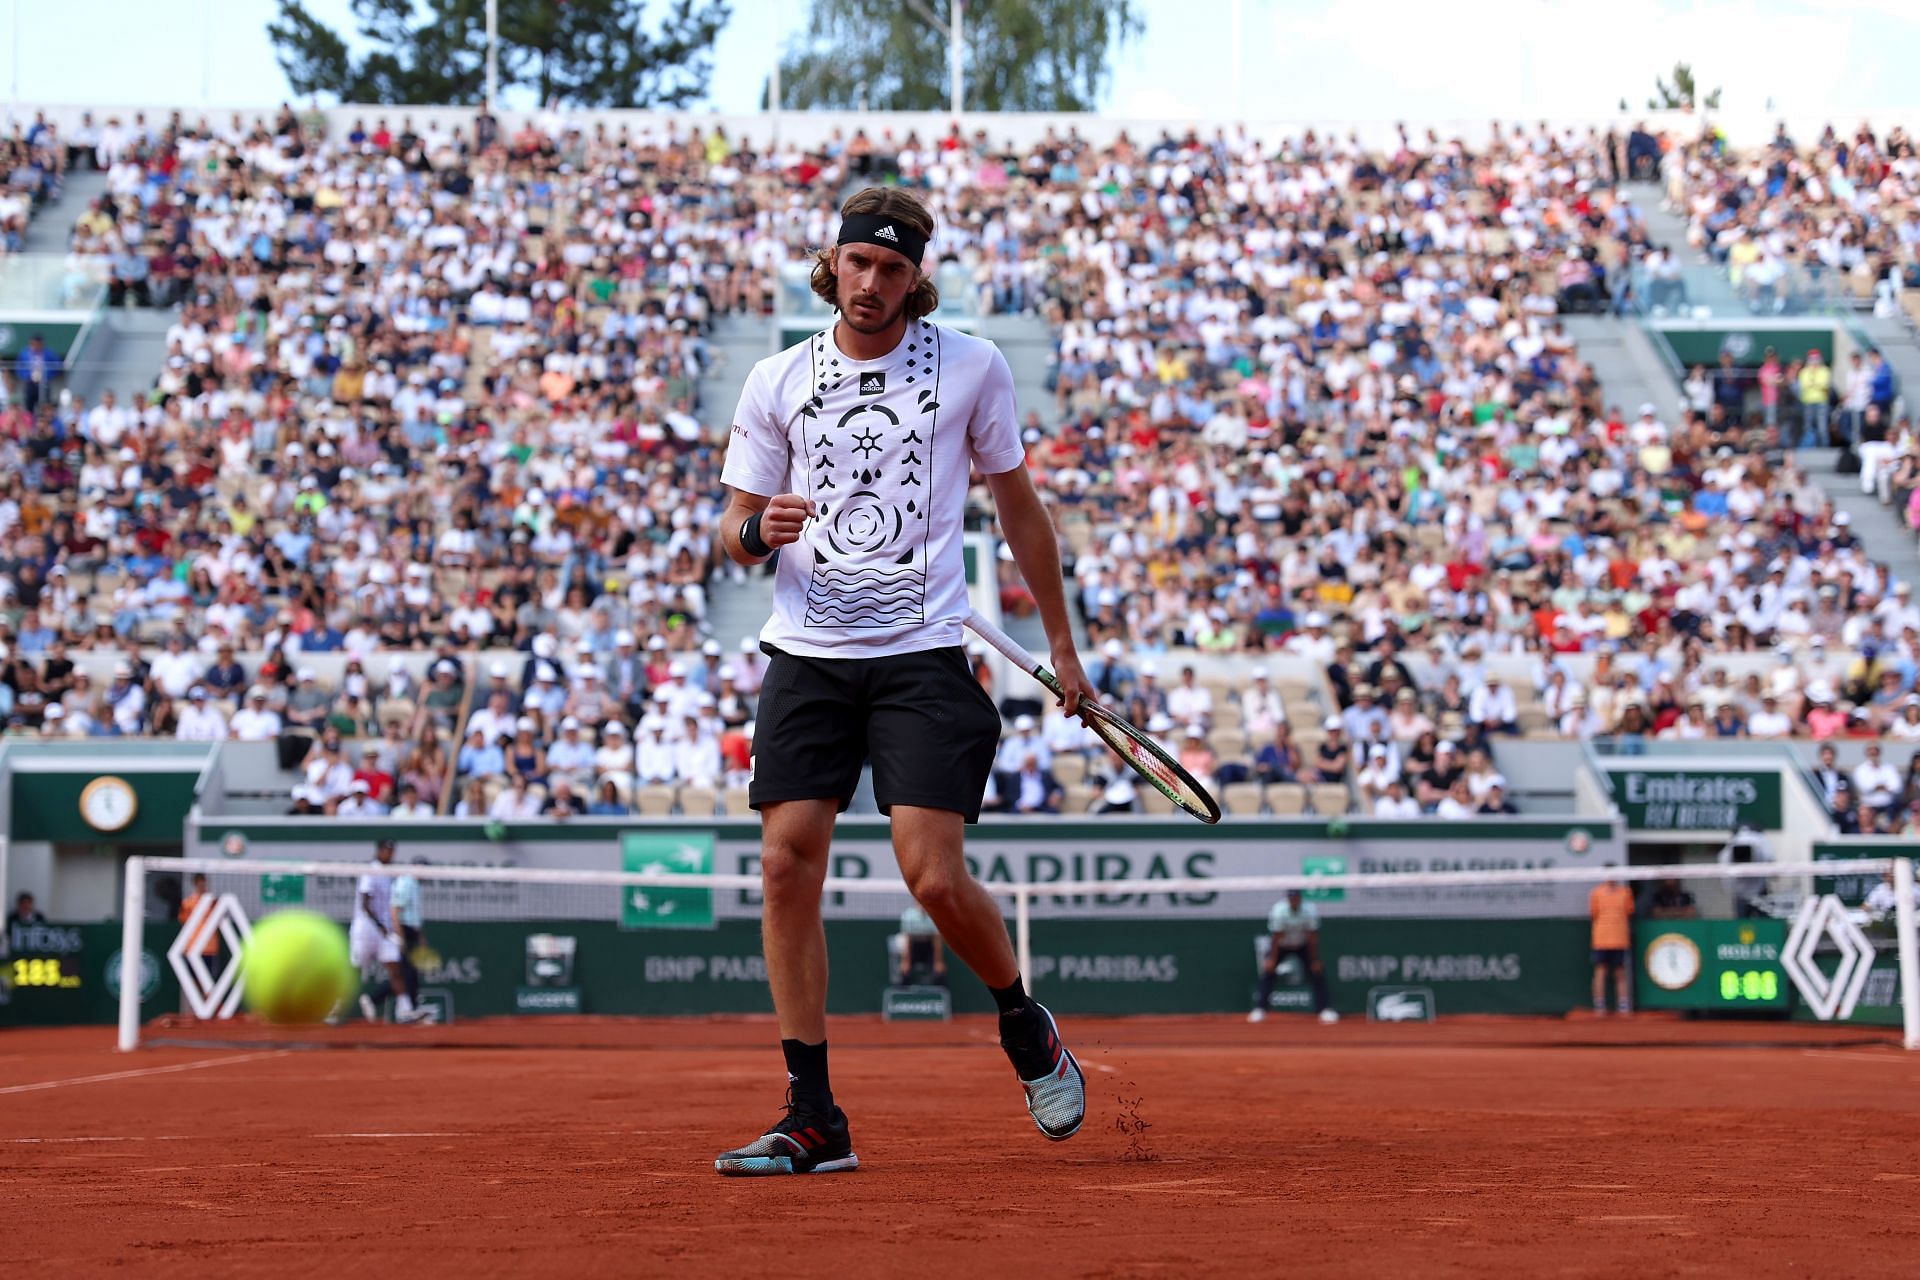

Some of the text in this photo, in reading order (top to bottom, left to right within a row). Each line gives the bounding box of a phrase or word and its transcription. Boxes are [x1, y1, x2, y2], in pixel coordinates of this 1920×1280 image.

[1624, 773, 1757, 804] Emirates
[1645, 804, 1675, 828] FLY
[737, 853, 870, 906] BP
[1059, 955, 1178, 982] PARIBAS
[1338, 954, 1520, 981] BNP PARIBAS
